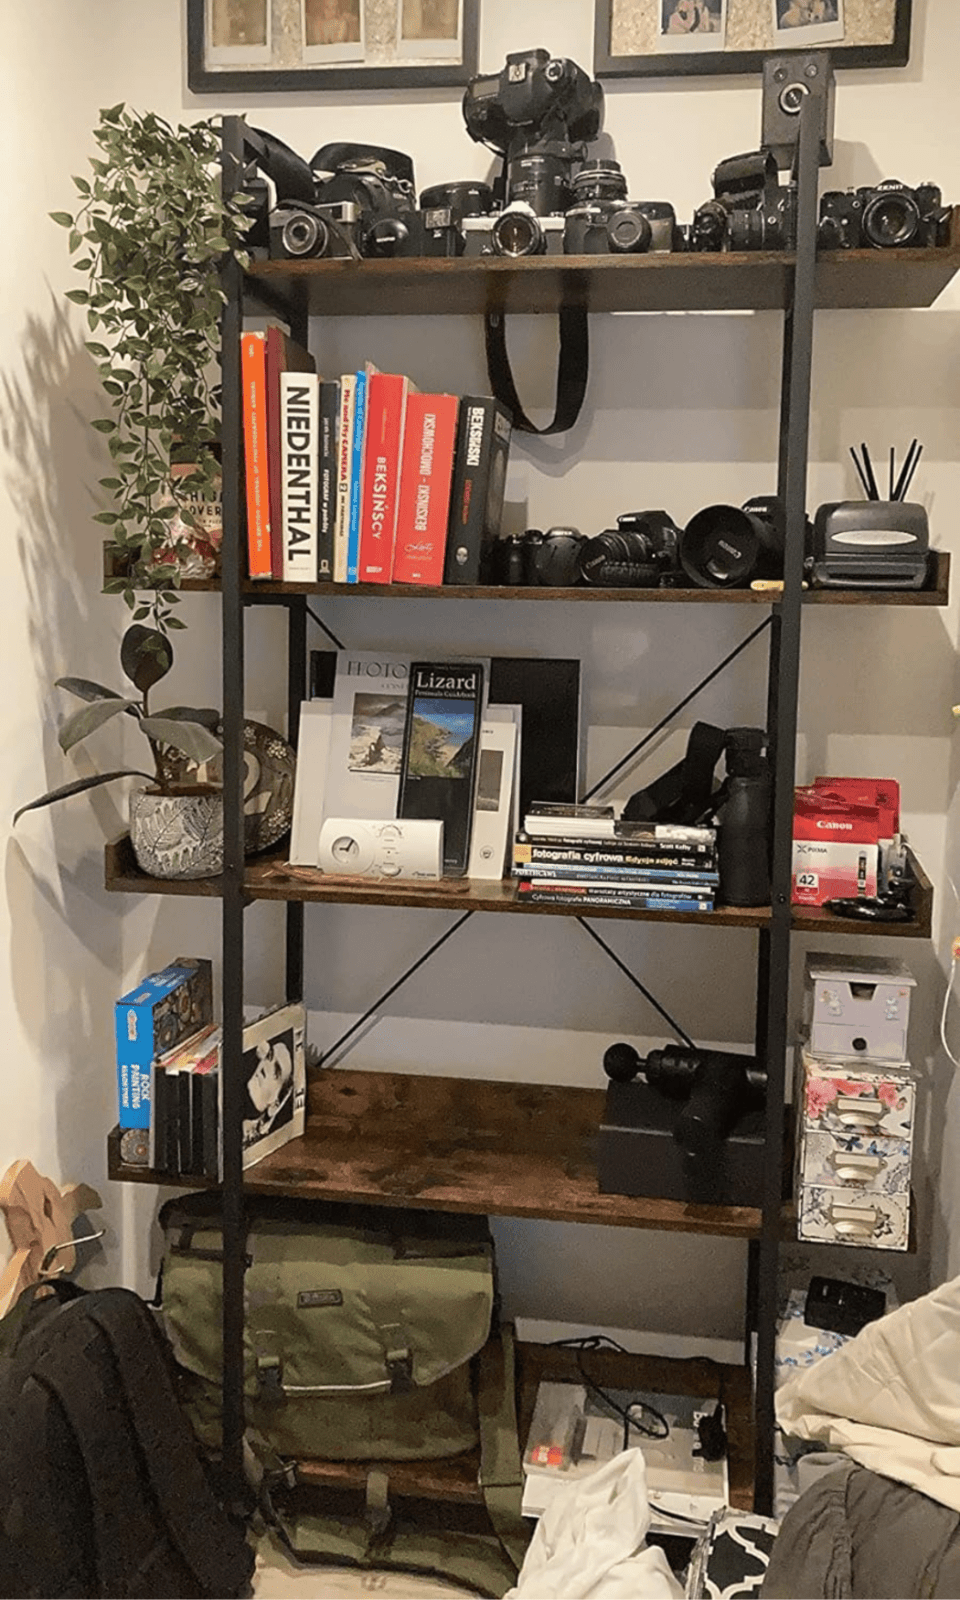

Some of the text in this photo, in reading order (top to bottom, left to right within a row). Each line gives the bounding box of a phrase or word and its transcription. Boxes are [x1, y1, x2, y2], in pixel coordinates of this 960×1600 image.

[286, 386, 311, 561] NIEDENTHAL
[340, 439, 348, 481] CAMERA
[322, 469, 330, 501] FOTOGRAF
[371, 456, 389, 540] BEKSIŃSCY
[416, 671, 476, 690] Lizard
[816, 820, 853, 830] Canon
[532, 849, 581, 862] fotografia
[583, 851, 624, 863] cyfrowa
[799, 874, 815, 886] 42
[130, 1064, 141, 1109] PAINTING
[140, 1073, 151, 1101] ROCK
